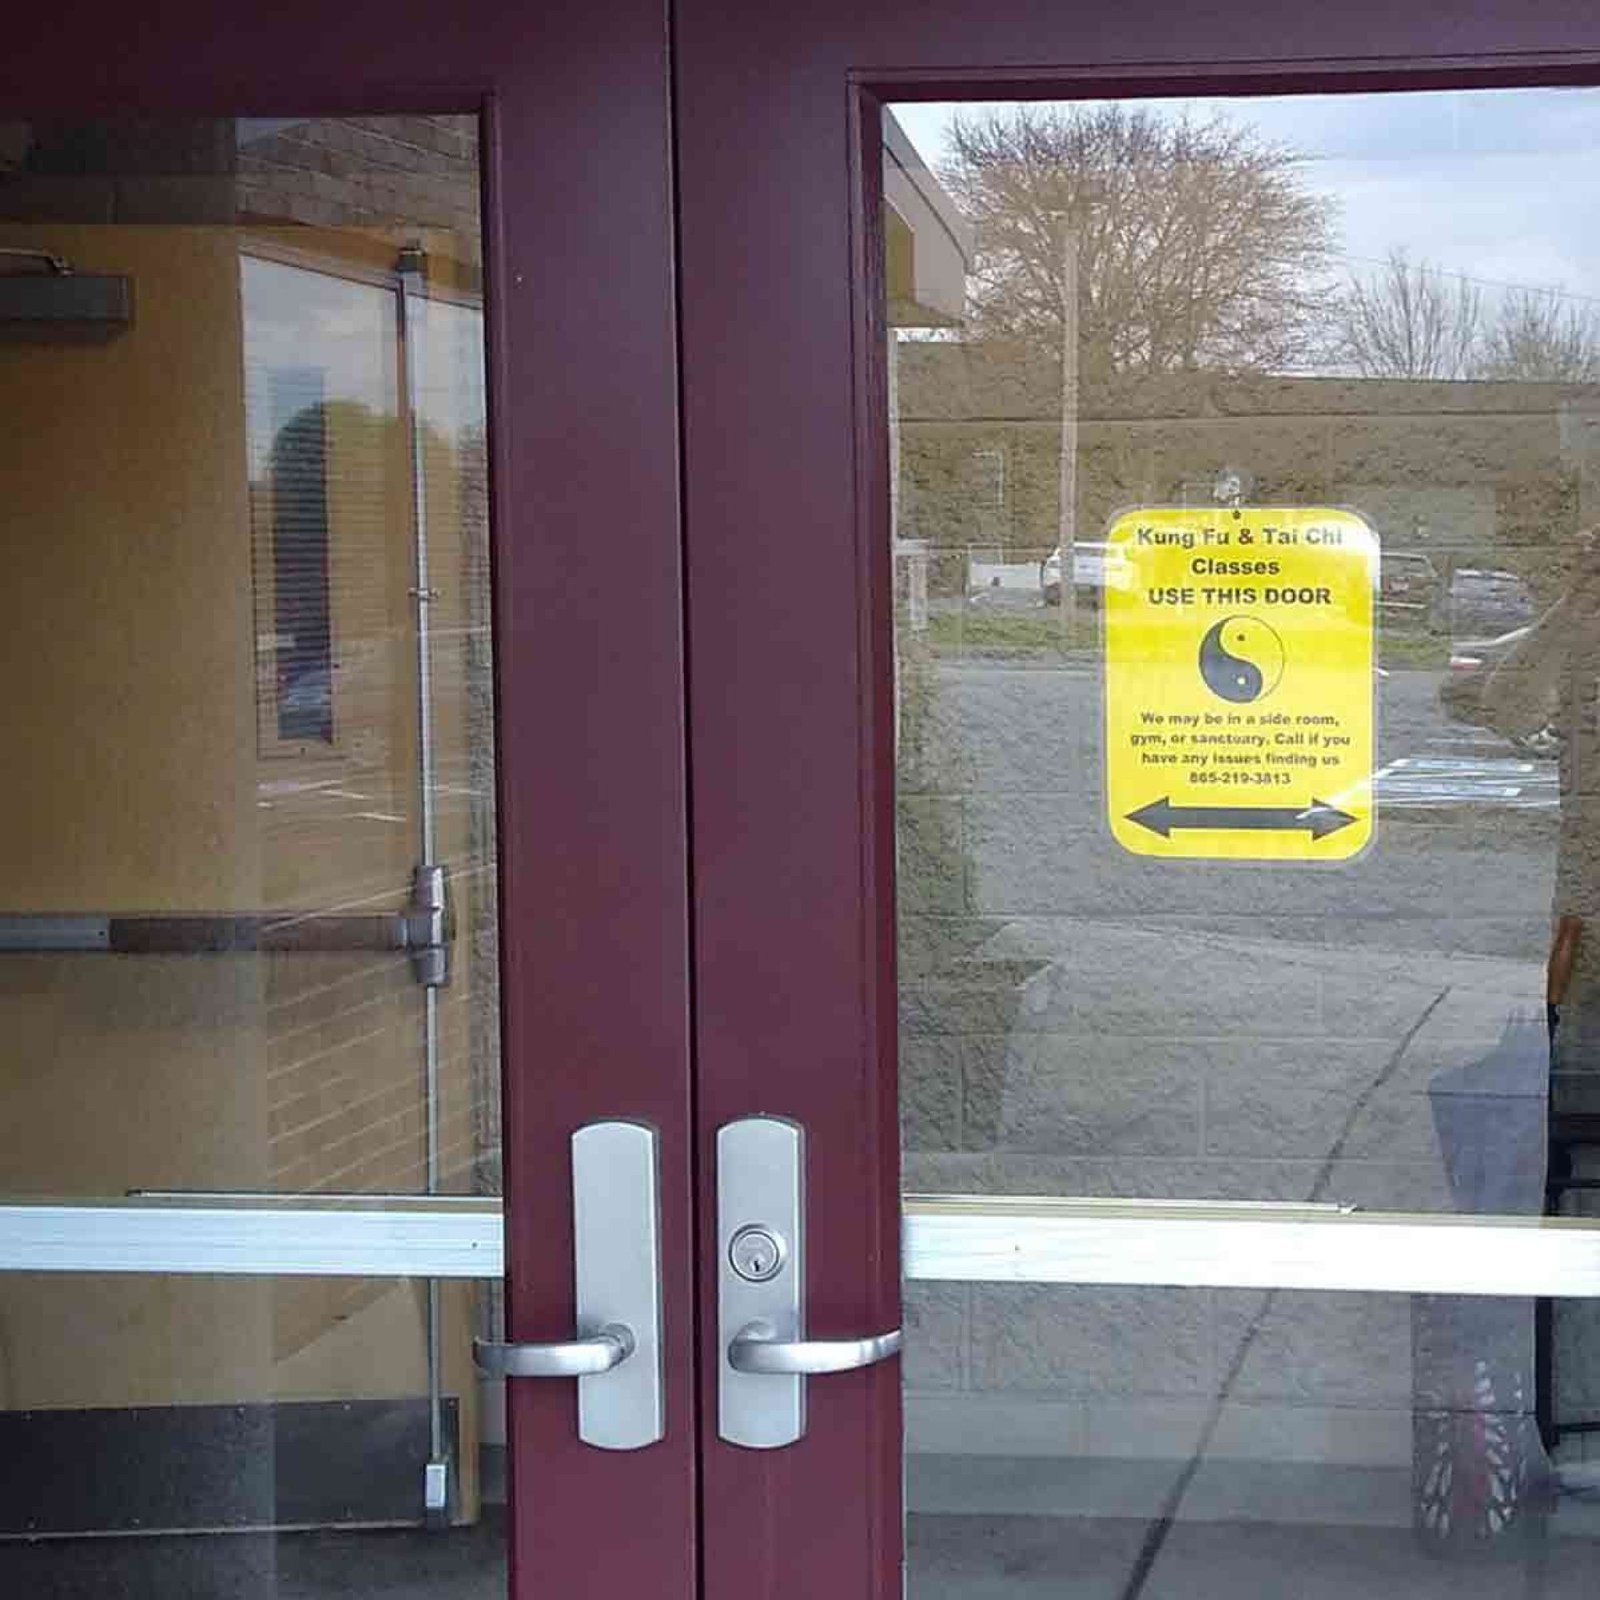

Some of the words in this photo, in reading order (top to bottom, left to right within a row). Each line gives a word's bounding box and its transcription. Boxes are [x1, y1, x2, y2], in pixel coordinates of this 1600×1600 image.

[1138, 527, 1195, 548] Kung
[1204, 529, 1229, 545] Fu
[1238, 529, 1254, 545] &
[1263, 528, 1297, 544] Tai
[1306, 528, 1343, 544] Chi
[1191, 558, 1280, 575] Classes
[1149, 588, 1194, 605] USE
[1203, 588, 1257, 605] THIS
[1265, 588, 1332, 604] DOOR
[1140, 712, 1164, 725] We
[1169, 715, 1200, 727] may
[1205, 712, 1223, 725] be
[1227, 712, 1241, 725] in
[1246, 715, 1255, 725] a
[1260, 712, 1291, 725] side
[1296, 715, 1340, 727] room,
[1130, 735, 1167, 747] gym,
[1170, 735, 1186, 745] or
[1275, 733, 1304, 745] Call
[1309, 733, 1319, 745] if
[1323, 735, 1351, 747] you
[1142, 753, 1177, 765] have
[1182, 756, 1208, 767] any
[1212, 753, 1261, 765] issues
[1265, 753, 1317, 767] finding
[1321, 755, 1340, 765] us
